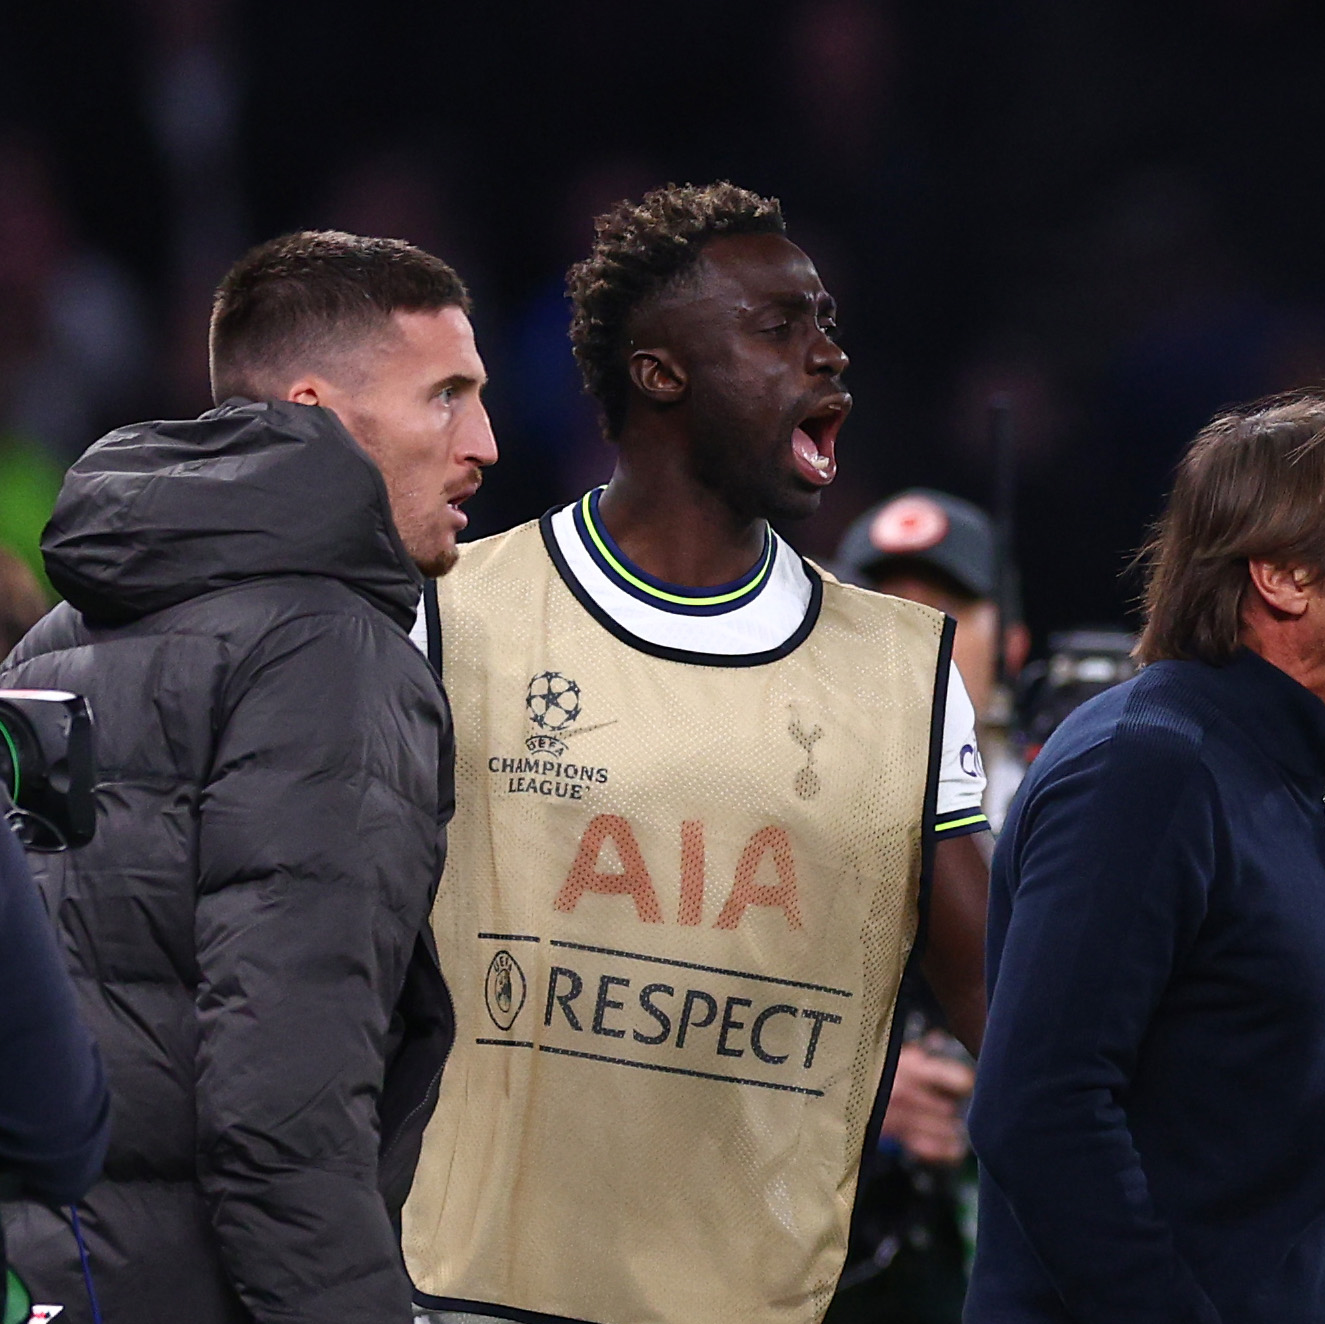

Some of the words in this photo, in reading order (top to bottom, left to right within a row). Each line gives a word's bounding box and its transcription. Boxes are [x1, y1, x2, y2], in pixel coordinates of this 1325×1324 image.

[488, 756, 609, 784] CHAMPIONS
[508, 776, 583, 800] LEAGUE
[553, 813, 802, 932] AIA
[544, 965, 843, 1070] RESPECT
